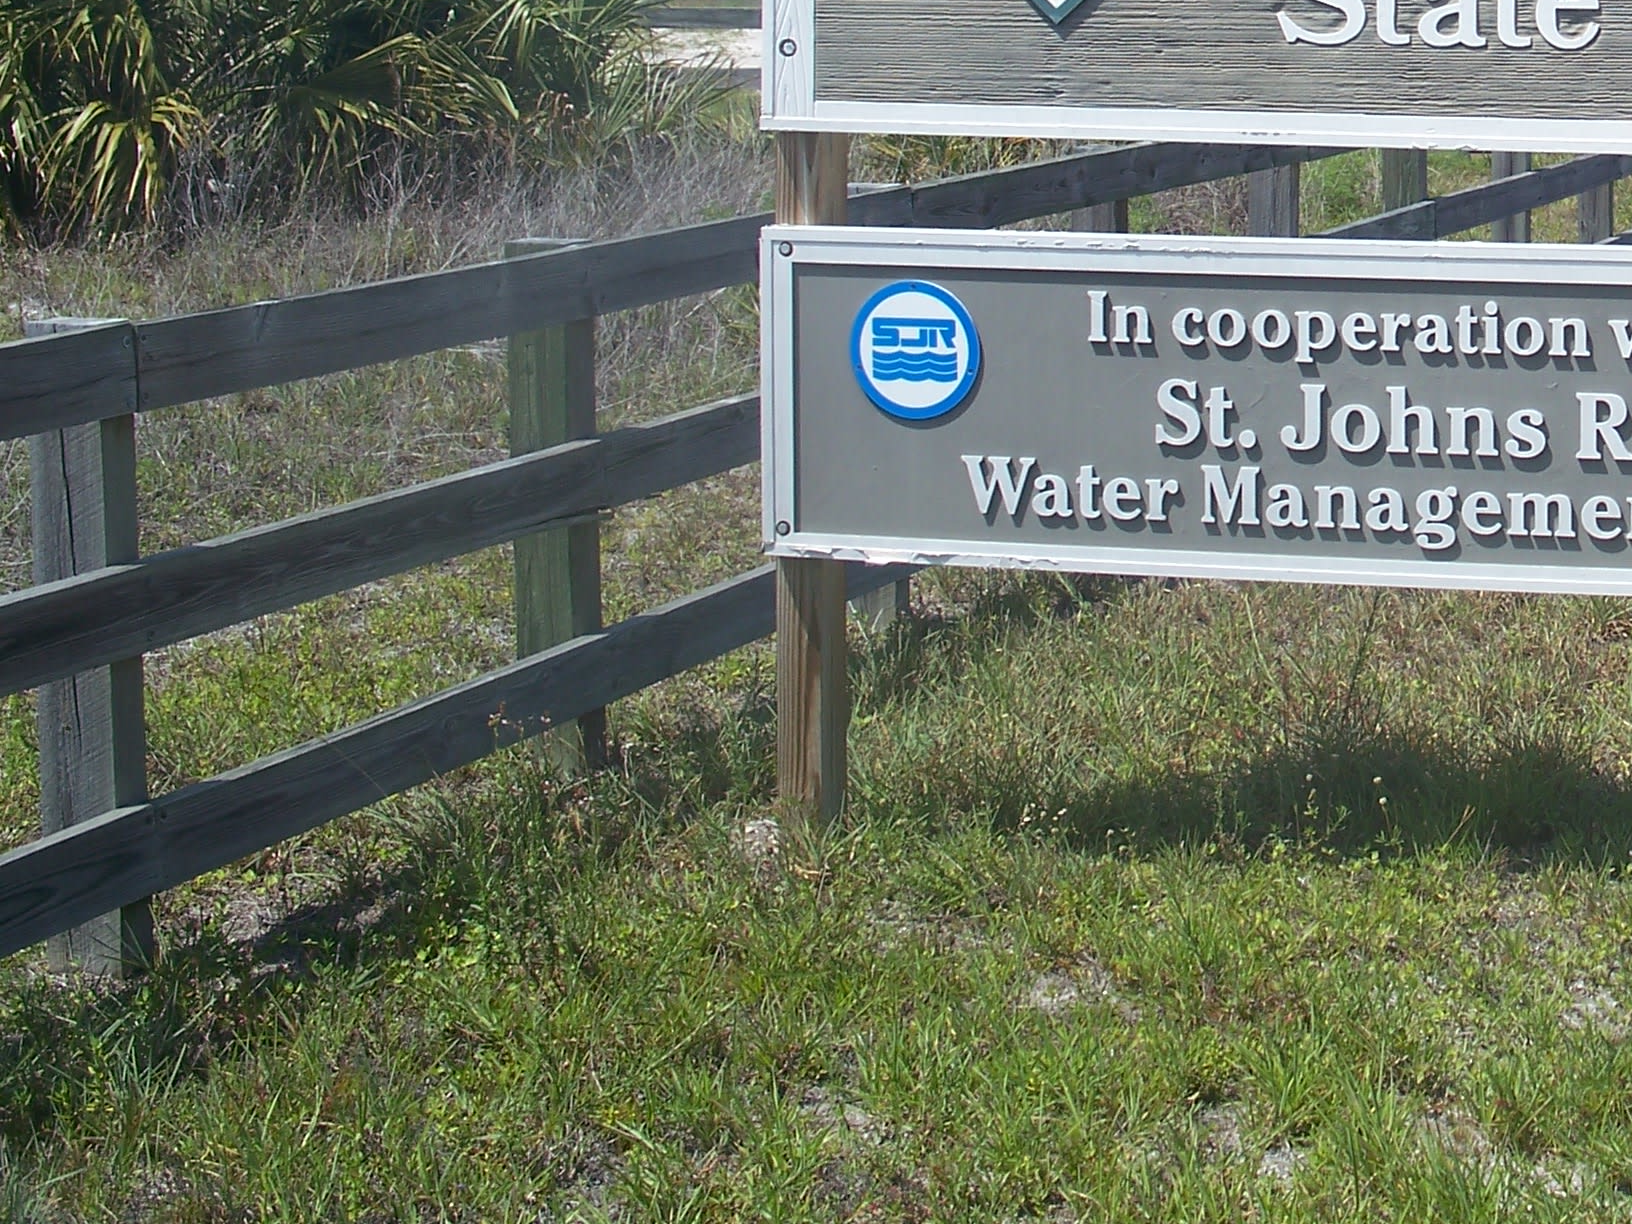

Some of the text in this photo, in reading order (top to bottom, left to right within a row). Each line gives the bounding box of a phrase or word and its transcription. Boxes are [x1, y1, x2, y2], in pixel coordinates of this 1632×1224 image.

[1087, 290, 1152, 343] In
[1171, 300, 1591, 363] cooperation
[1155, 378, 1256, 448] St.
[1280, 383, 1546, 458] Johns
[961, 454, 1179, 521] Water
